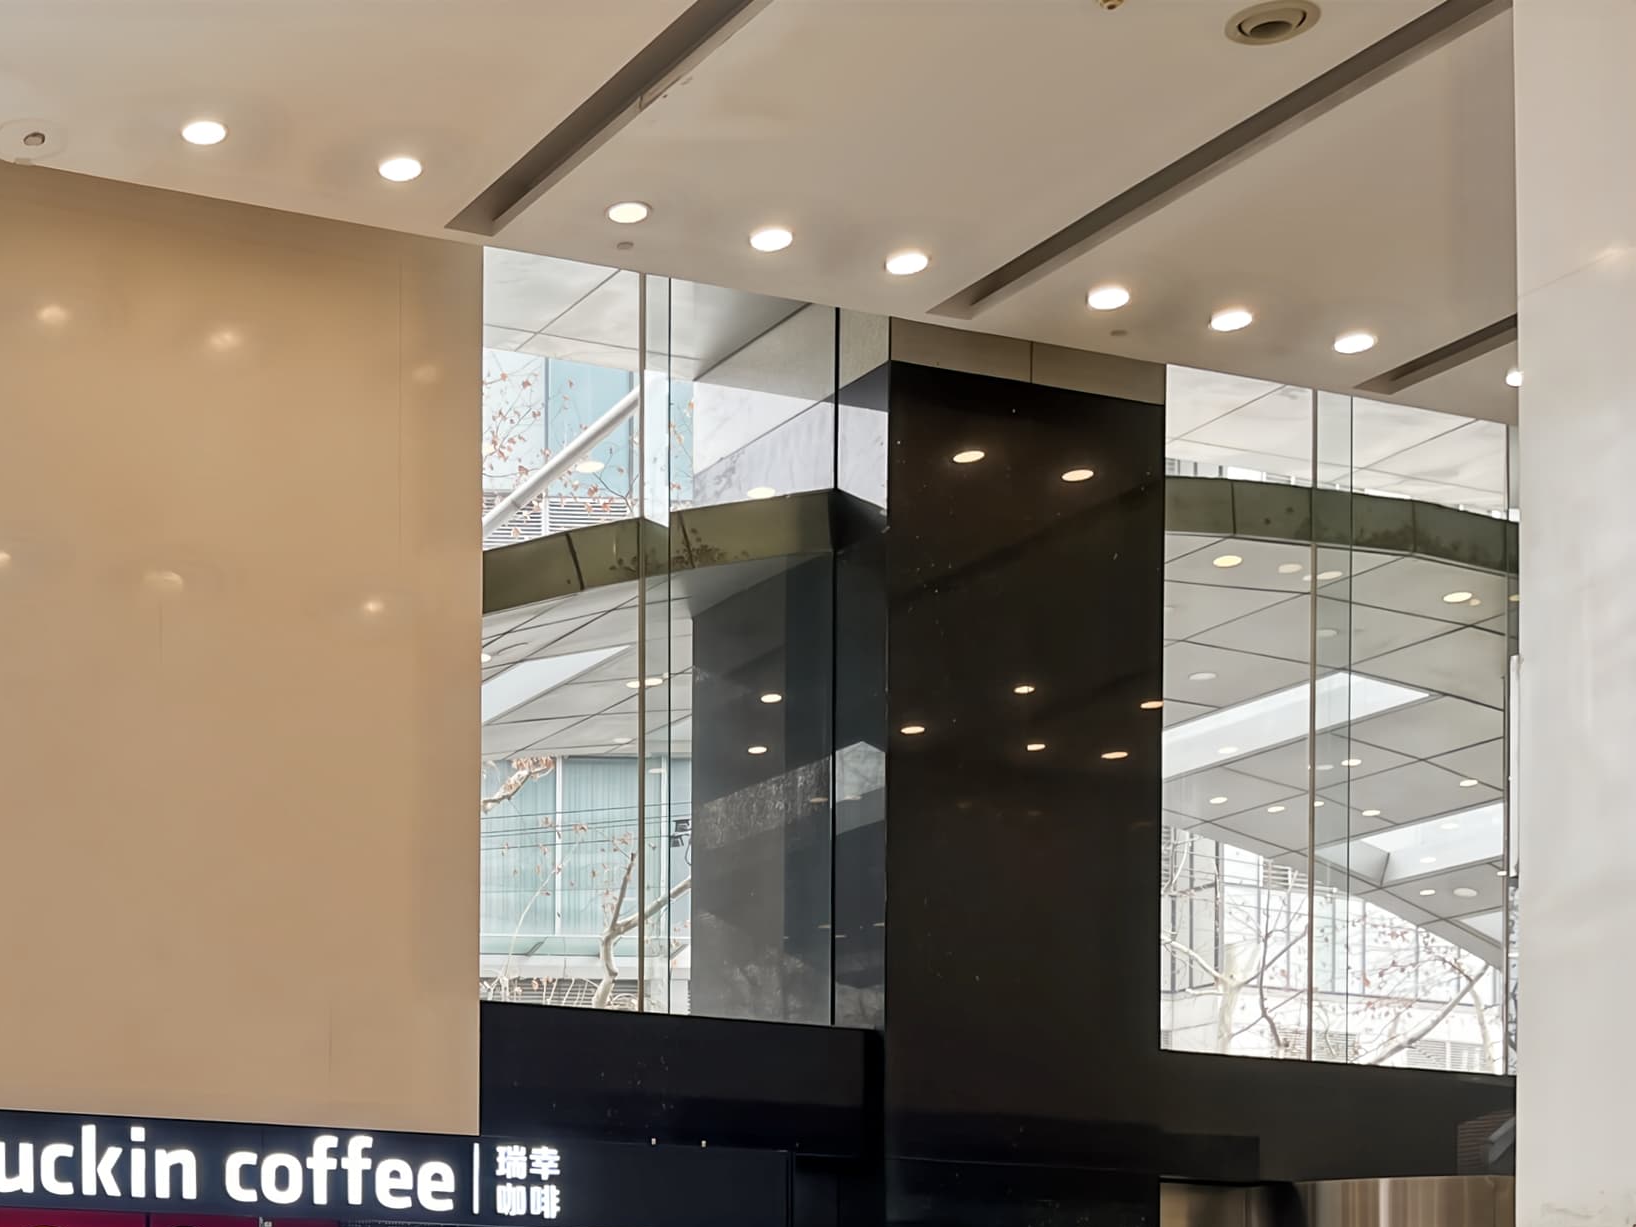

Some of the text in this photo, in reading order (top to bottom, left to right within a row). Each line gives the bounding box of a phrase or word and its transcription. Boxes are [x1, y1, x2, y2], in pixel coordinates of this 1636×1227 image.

[225, 1135, 455, 1212] coffee
[495, 1145, 561, 1182] 瑞幸
[495, 1182, 561, 1219] 咖啡
